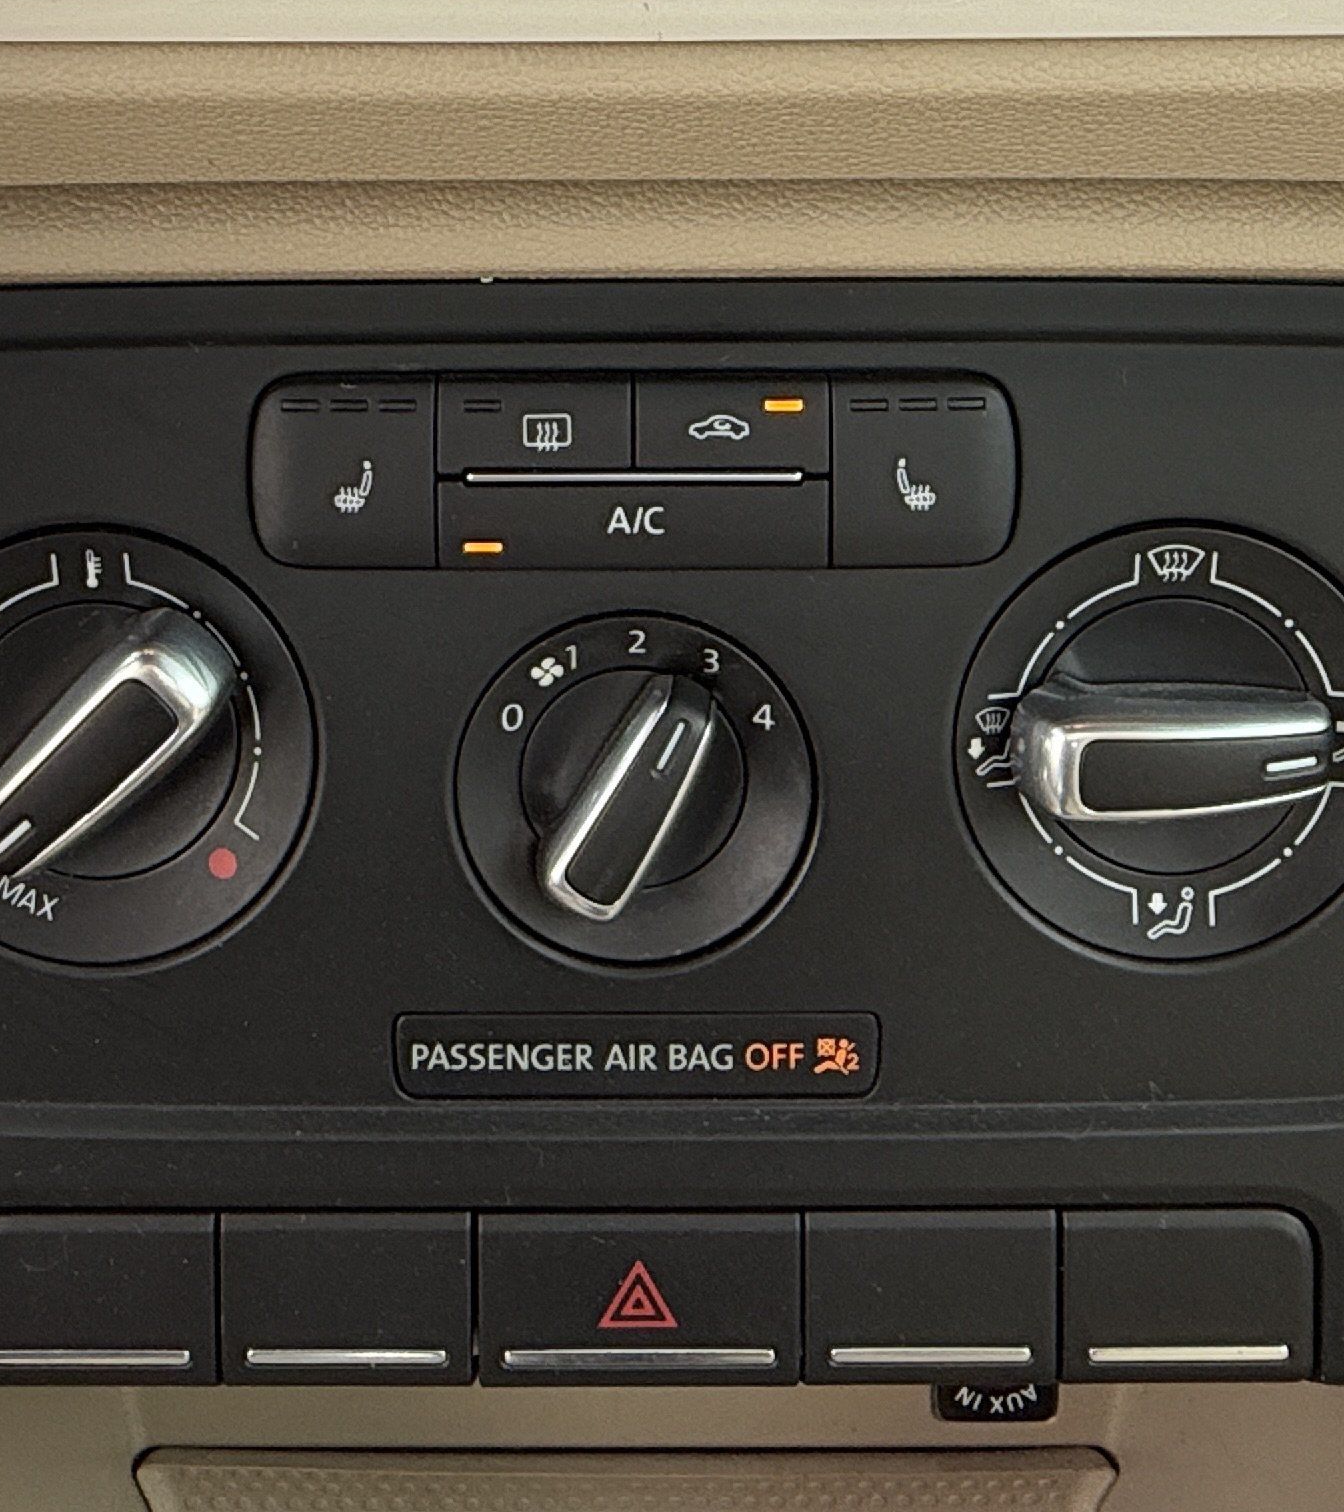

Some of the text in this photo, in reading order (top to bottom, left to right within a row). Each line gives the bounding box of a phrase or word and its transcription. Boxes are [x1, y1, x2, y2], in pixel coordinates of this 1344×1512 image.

[606, 505, 667, 536] A/C
[627, 630, 646, 654] 2
[565, 644, 579, 670] 1
[703, 648, 721, 673] 3
[501, 703, 524, 732] 0
[752, 704, 776, 731] 4
[410, 1042, 805, 1072] PASSENGER AIR BAG OFF
[954, 1383, 1038, 1414] AUX IN
